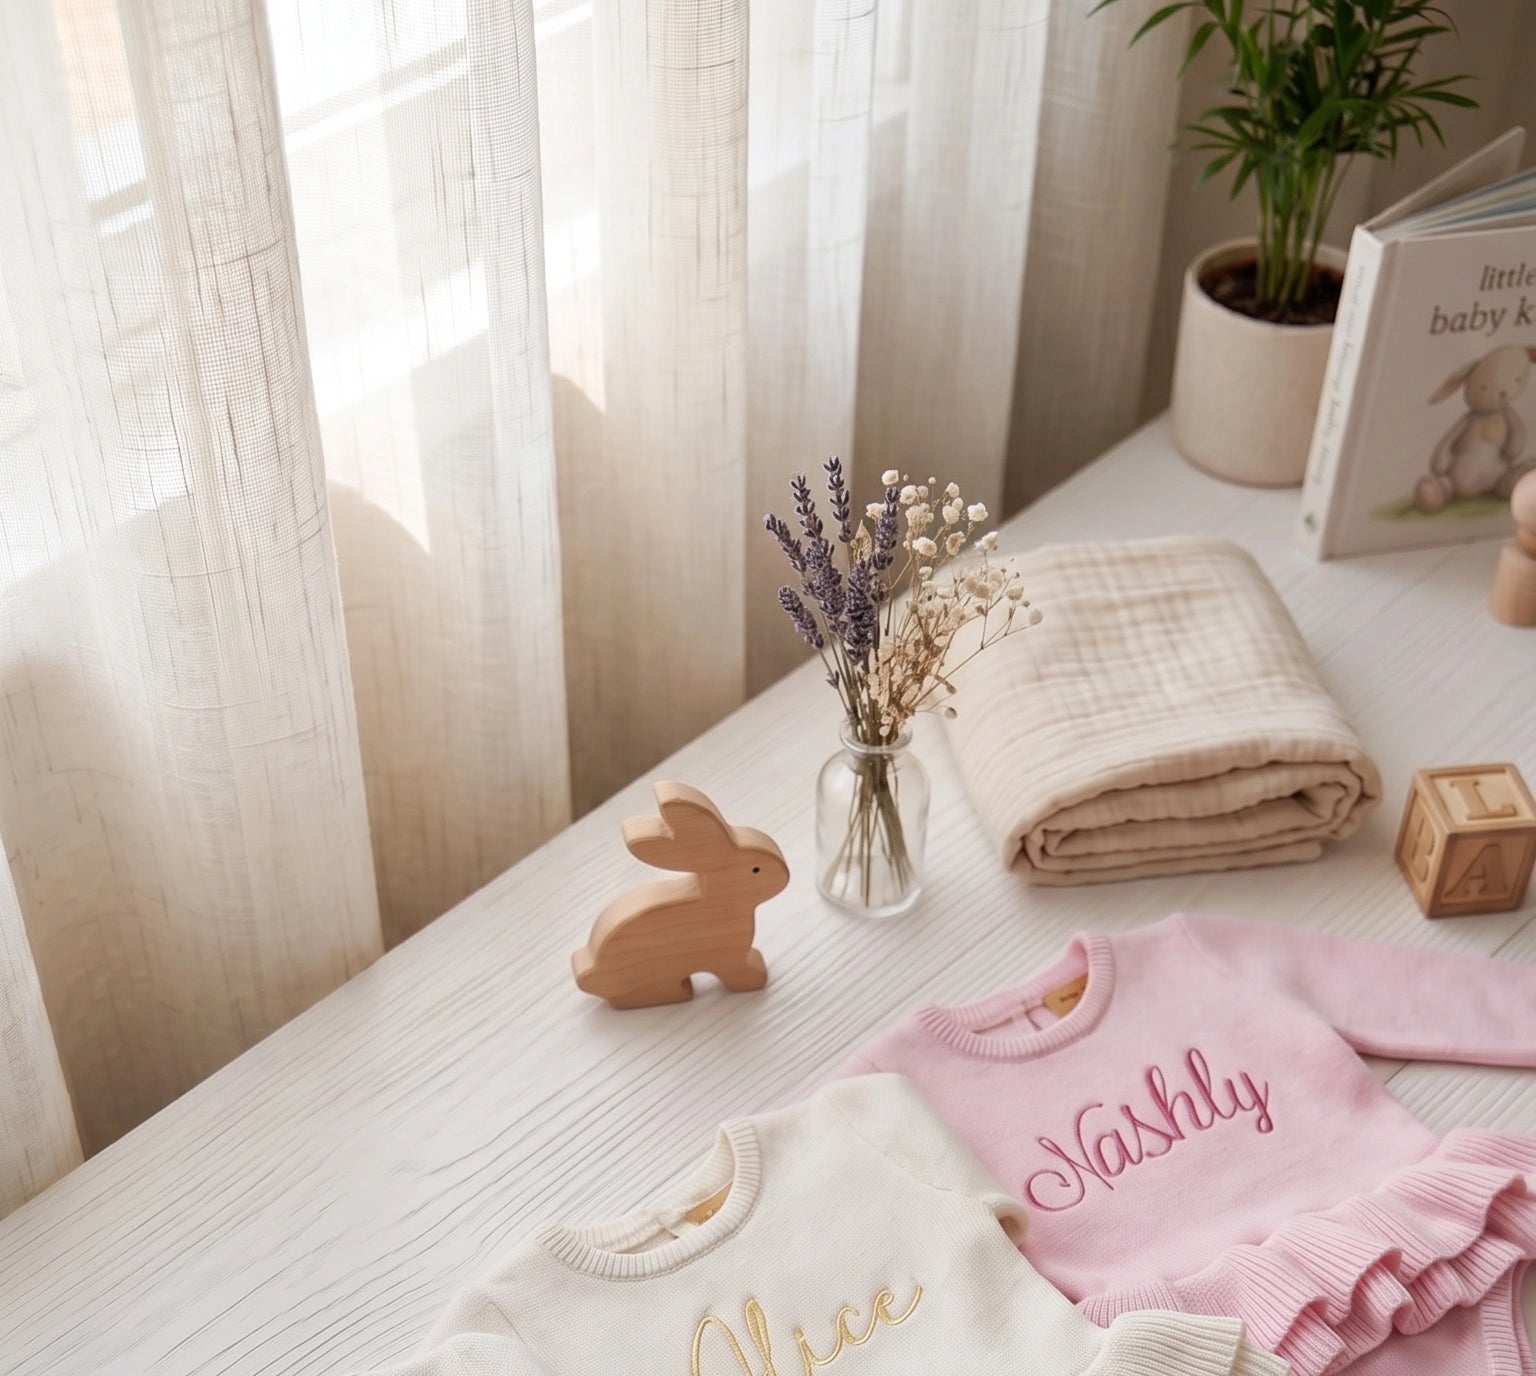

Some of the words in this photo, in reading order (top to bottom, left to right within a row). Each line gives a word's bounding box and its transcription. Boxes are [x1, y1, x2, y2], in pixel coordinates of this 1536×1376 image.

[1480, 262, 1536, 291] little
[1430, 301, 1507, 338] baby
[1449, 779, 1518, 821] L
[1444, 843, 1510, 897] A
[1024, 1047, 1274, 1213] Nashly
